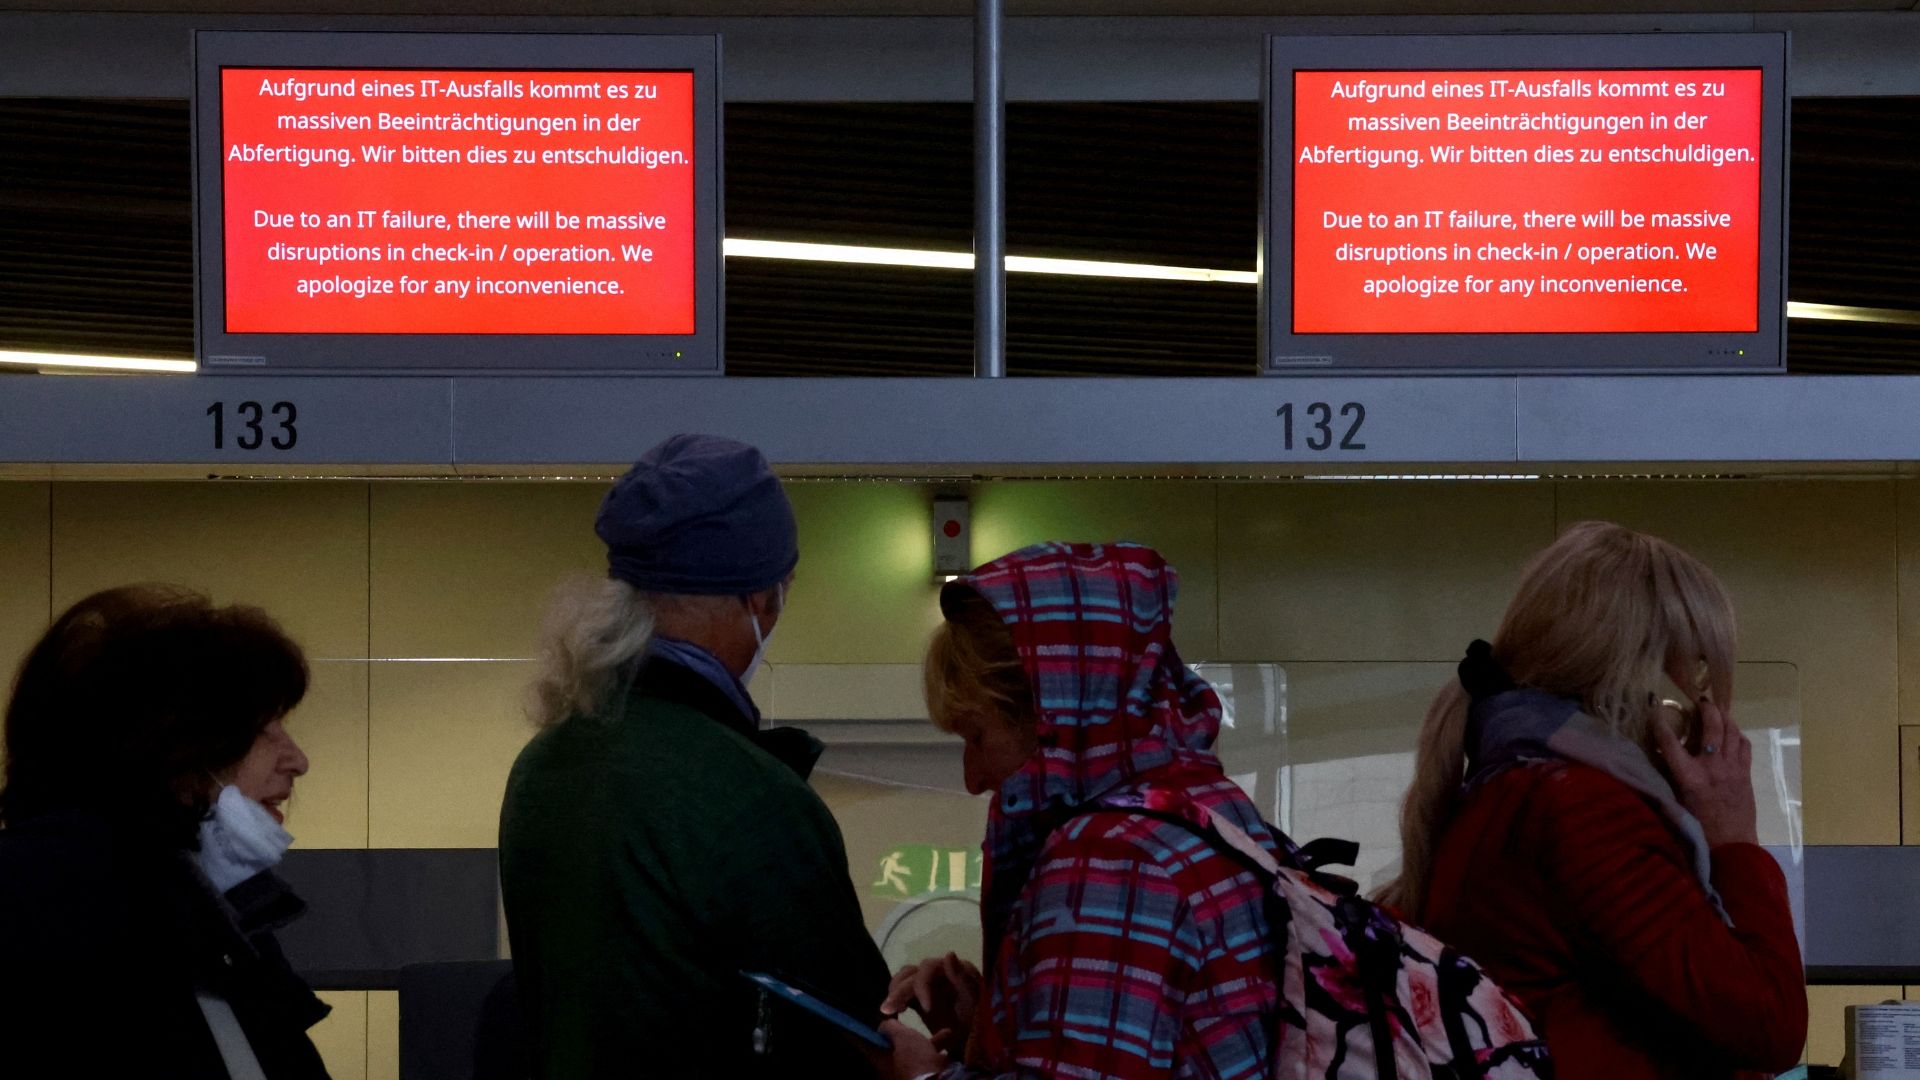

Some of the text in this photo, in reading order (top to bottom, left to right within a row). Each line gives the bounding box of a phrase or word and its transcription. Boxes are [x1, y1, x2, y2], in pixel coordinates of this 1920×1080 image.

[258, 77, 657, 102] Aufgrund eines IT-Ausfalls kommt es zu
[1330, 78, 1725, 104] Aufgrund eines IT-Ausfalls kommt es zu
[277, 111, 641, 137] massiven Beeinträchtigungen in der
[1348, 111, 1708, 136] massiven Beeinträchtigungen in der
[227, 143, 689, 170] Abfertigung. Wir bitten dies zu entschuldigen.
[1298, 143, 1755, 169] Abfertigung. Wir bitten dies zu entschuldigen.
[254, 209, 667, 231] Due to an IT failure, there will be massive
[1323, 209, 1731, 231] Due to an IT failure, there will be massive
[267, 241, 653, 267] disruptions in check-in / operation. We
[1335, 241, 1717, 266] disruptions in check-in / operation. We
[296, 274, 625, 299] apologize for any inconvenience.
[1363, 274, 1688, 299] apologize for any inconvenience.
[205, 400, 298, 451] 133
[1276, 402, 1366, 451] 132
